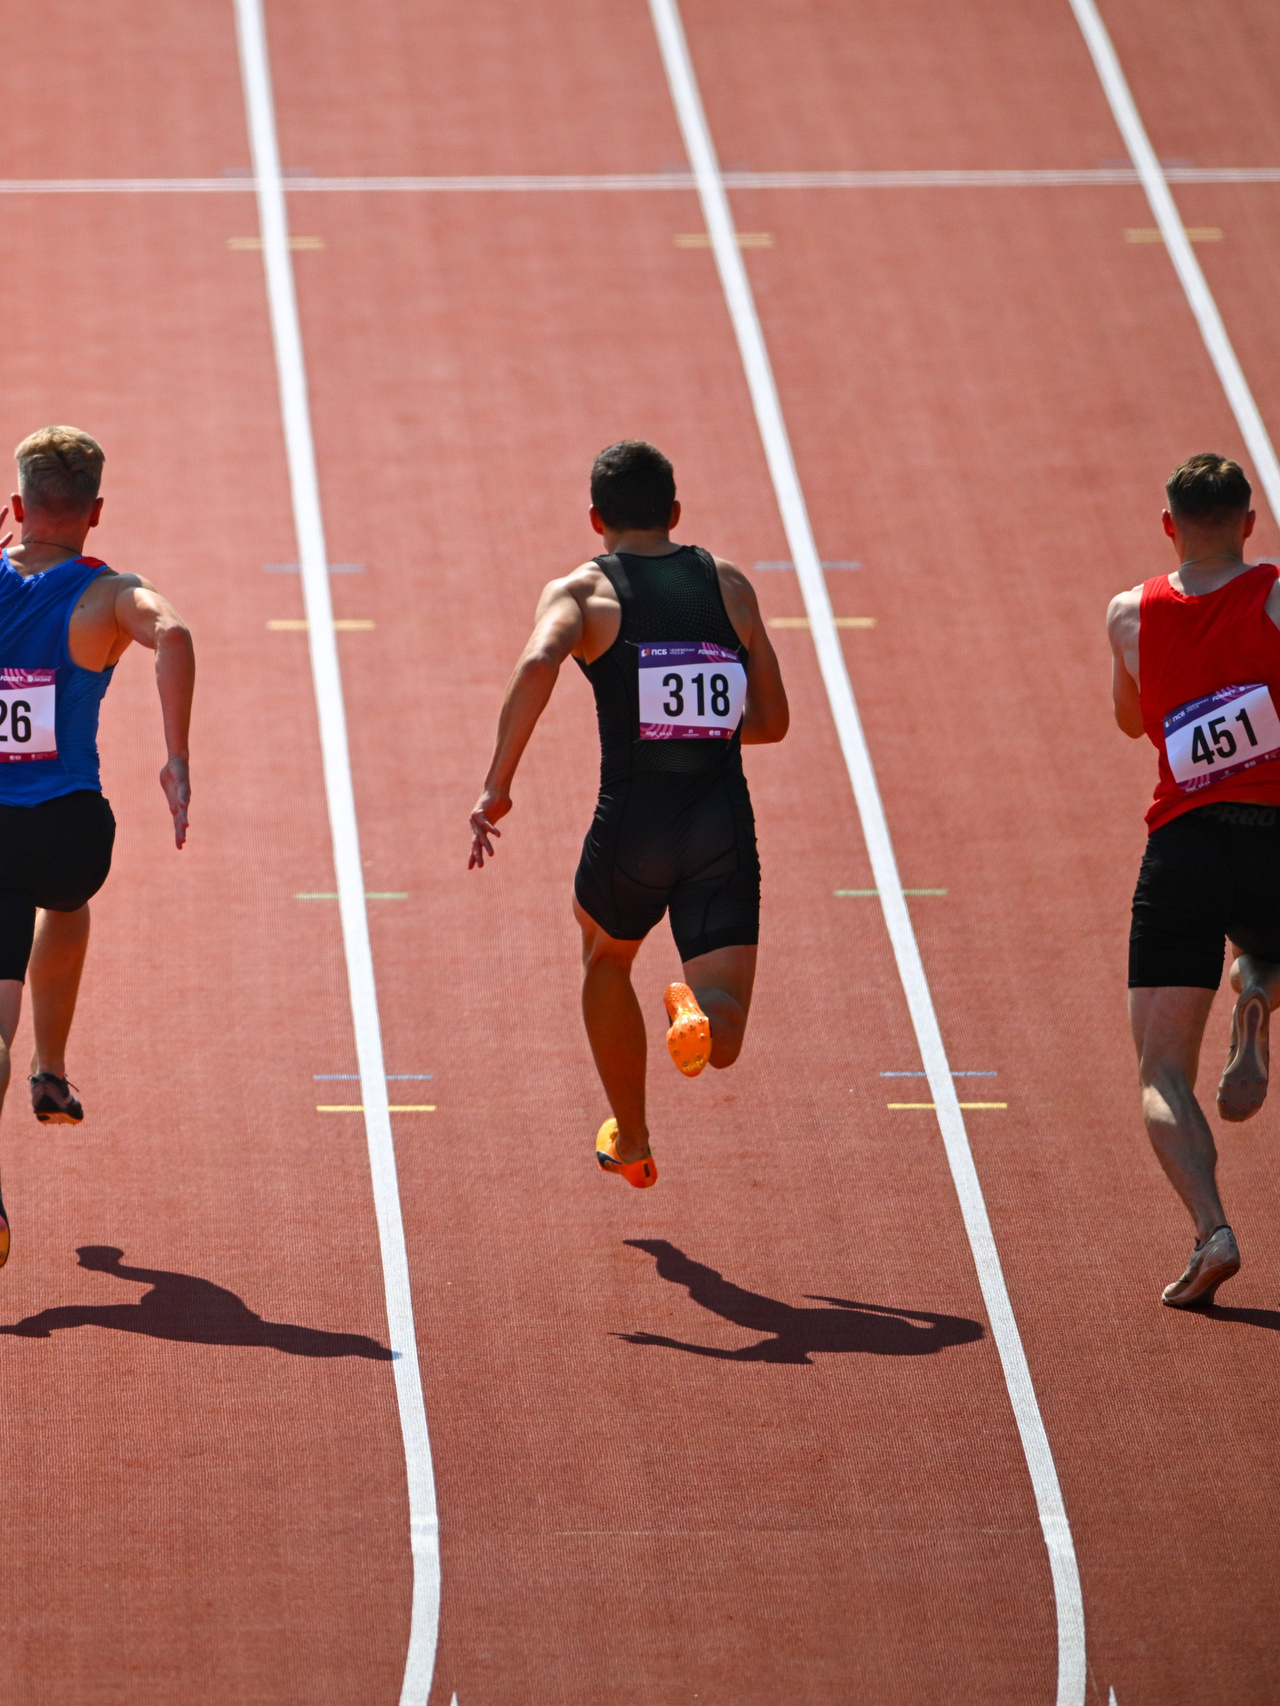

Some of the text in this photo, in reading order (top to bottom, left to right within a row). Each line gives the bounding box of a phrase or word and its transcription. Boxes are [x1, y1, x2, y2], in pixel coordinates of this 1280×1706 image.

[651, 648, 667, 656] ПСБ
[662, 673, 730, 717] 318
[1191, 708, 1259, 766] 451
